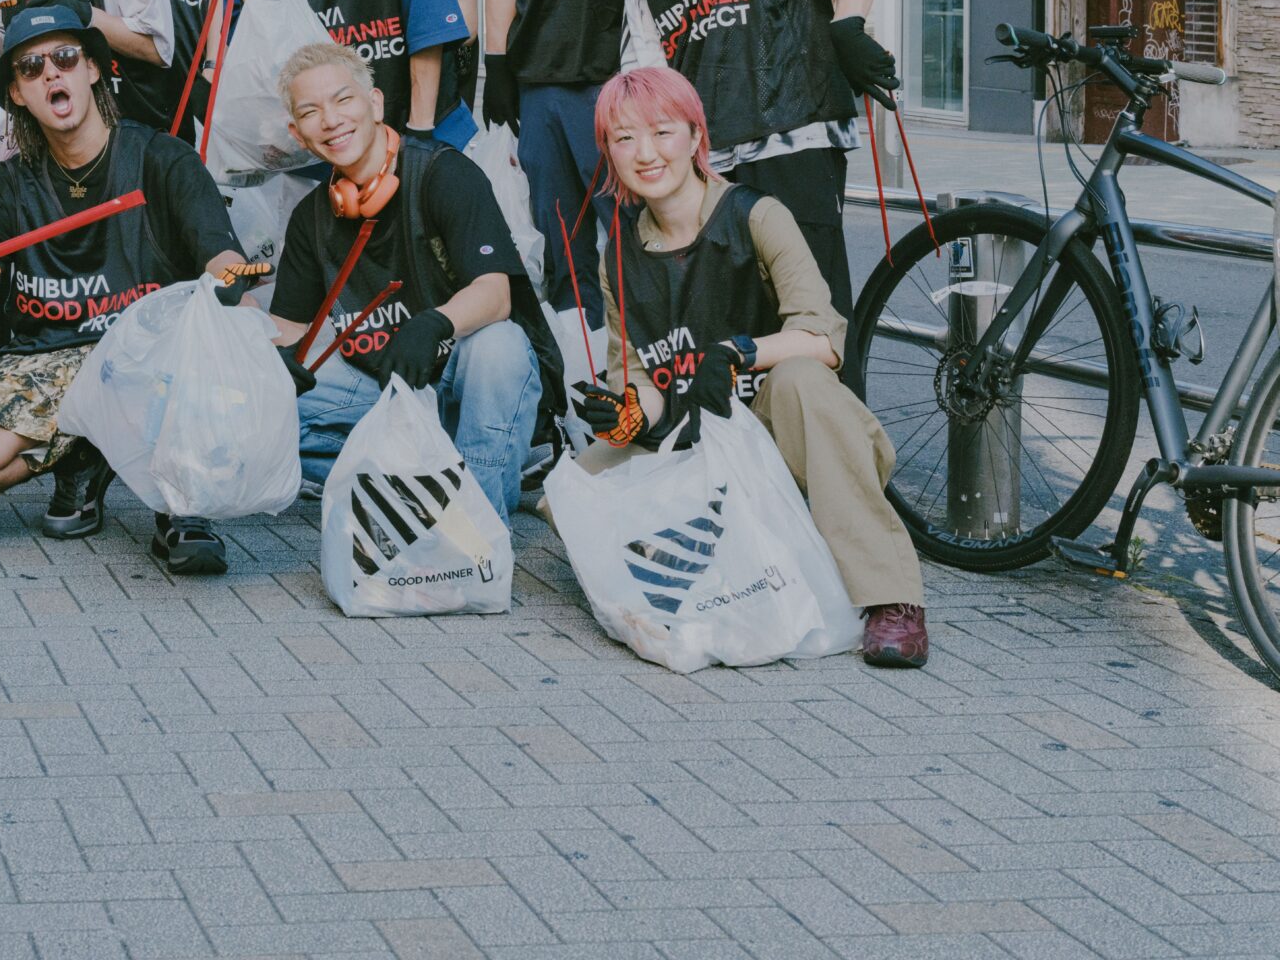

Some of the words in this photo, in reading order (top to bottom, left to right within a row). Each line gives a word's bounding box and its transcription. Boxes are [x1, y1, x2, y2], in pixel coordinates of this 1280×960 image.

[16, 271, 111, 299] SHIBUYA
[16, 293, 82, 321] GOOD
[388, 575, 423, 587] GOOD
[425, 567, 474, 583] MANNER
